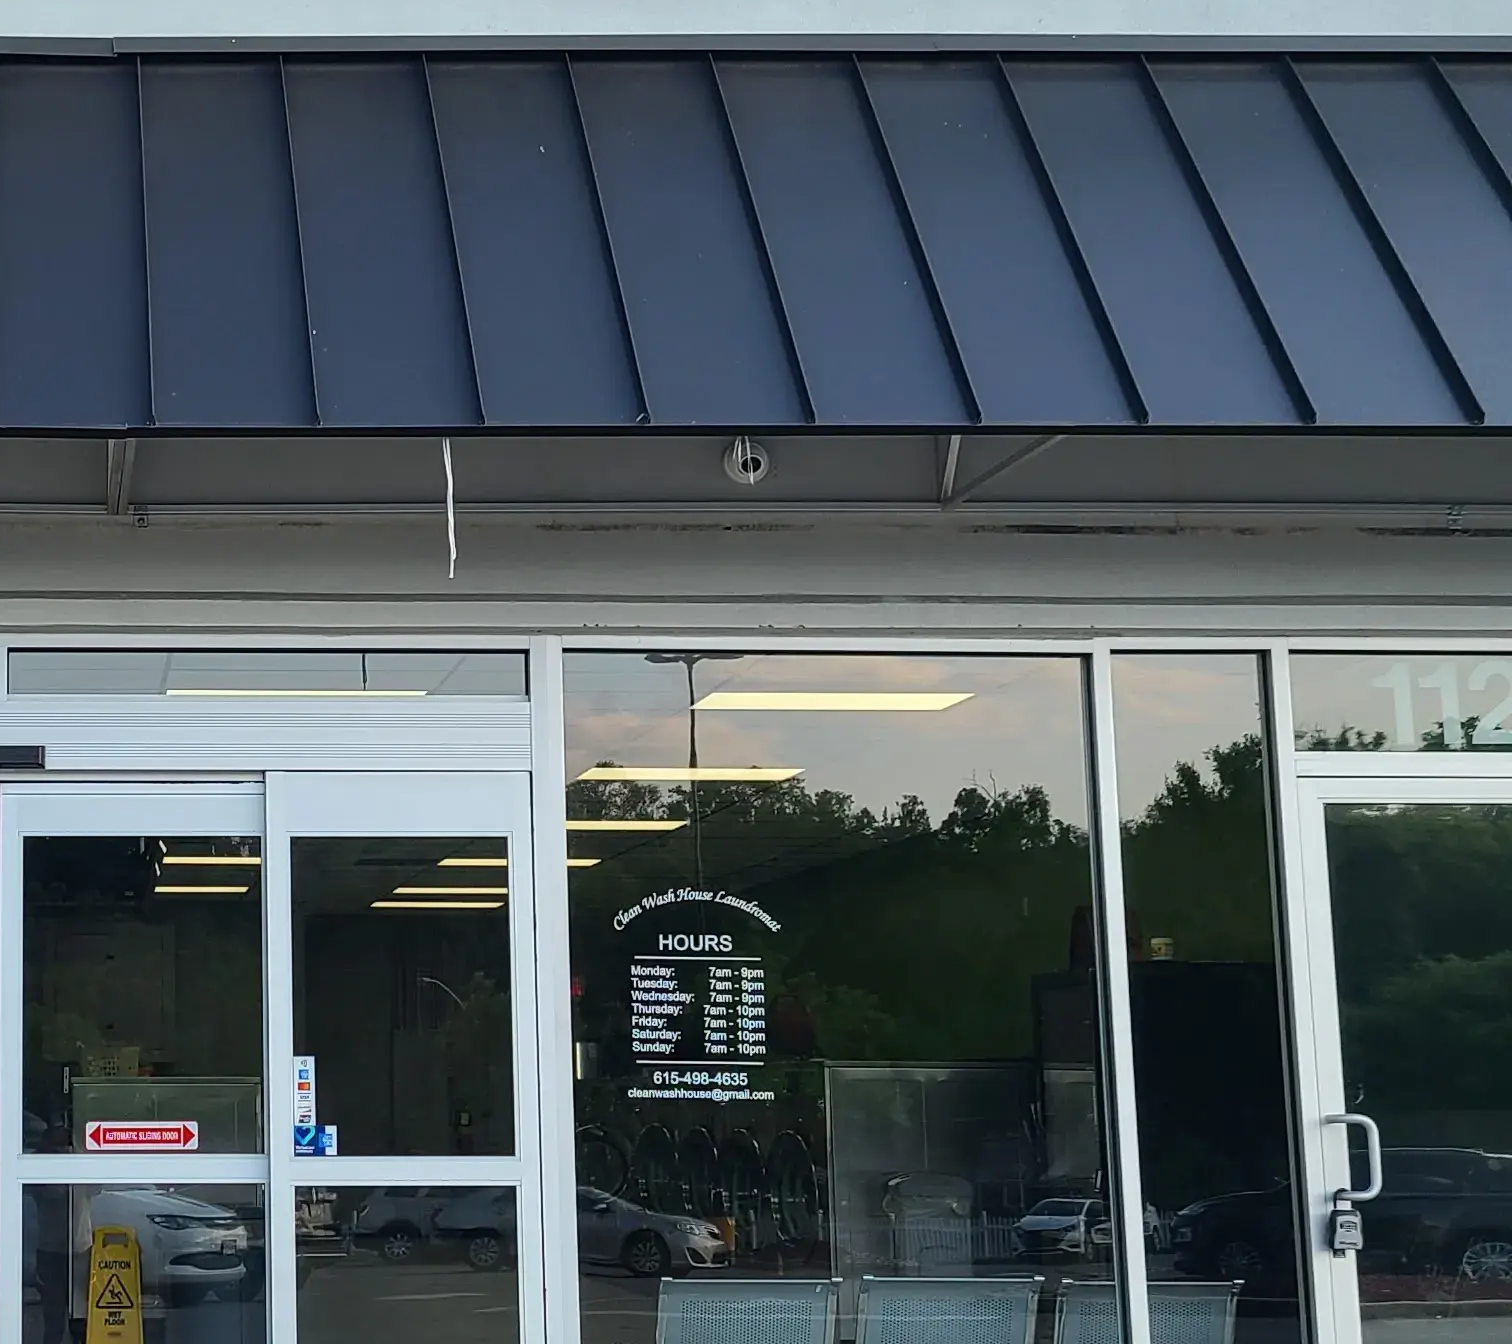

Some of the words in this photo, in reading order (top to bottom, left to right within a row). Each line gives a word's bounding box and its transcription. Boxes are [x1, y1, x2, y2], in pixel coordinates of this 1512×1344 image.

[613, 904, 643, 931] Clean
[642, 888, 676, 911] Wash
[676, 887, 713, 901] House
[714, 891, 782, 932] Laundromat
[658, 934, 733, 952] HOURS
[630, 965, 675, 978] Monday:
[708, 967, 731, 977] 7am
[741, 967, 764, 979] 9pm
[630, 978, 678, 990] Tuesday:
[709, 979, 732, 990] 7am
[741, 980, 764, 992] 9pm
[631, 991, 695, 1004] Wednesday:
[709, 992, 732, 1002] 7am
[741, 993, 764, 1004] 9pm
[631, 1003, 683, 1016] Thursday:
[703, 1005, 726, 1015] 7am
[736, 1005, 765, 1017] 10pm
[632, 1016, 667, 1028] Friday:
[703, 1018, 727, 1028] 7am
[736, 1018, 765, 1030] 10pm
[632, 1028, 681, 1041] Saturday:
[704, 1030, 727, 1041] 7am
[737, 1031, 766, 1043] 10pm
[632, 1041, 675, 1054] Sunday:
[704, 1043, 727, 1053] 7am
[737, 1043, 766, 1056] 10pm
[653, 1071, 748, 1085] 615-498-4635
[628, 1087, 775, 1101] cleanwashhouse@gmail.com
[105, 1131, 138, 1140] AUTOMATIC
[138, 1131, 161, 1140] SLIDING
[162, 1131, 178, 1140] DOOR
[99, 1260, 131, 1269] CAUTION
[104, 1318, 125, 1326] FLOOR
